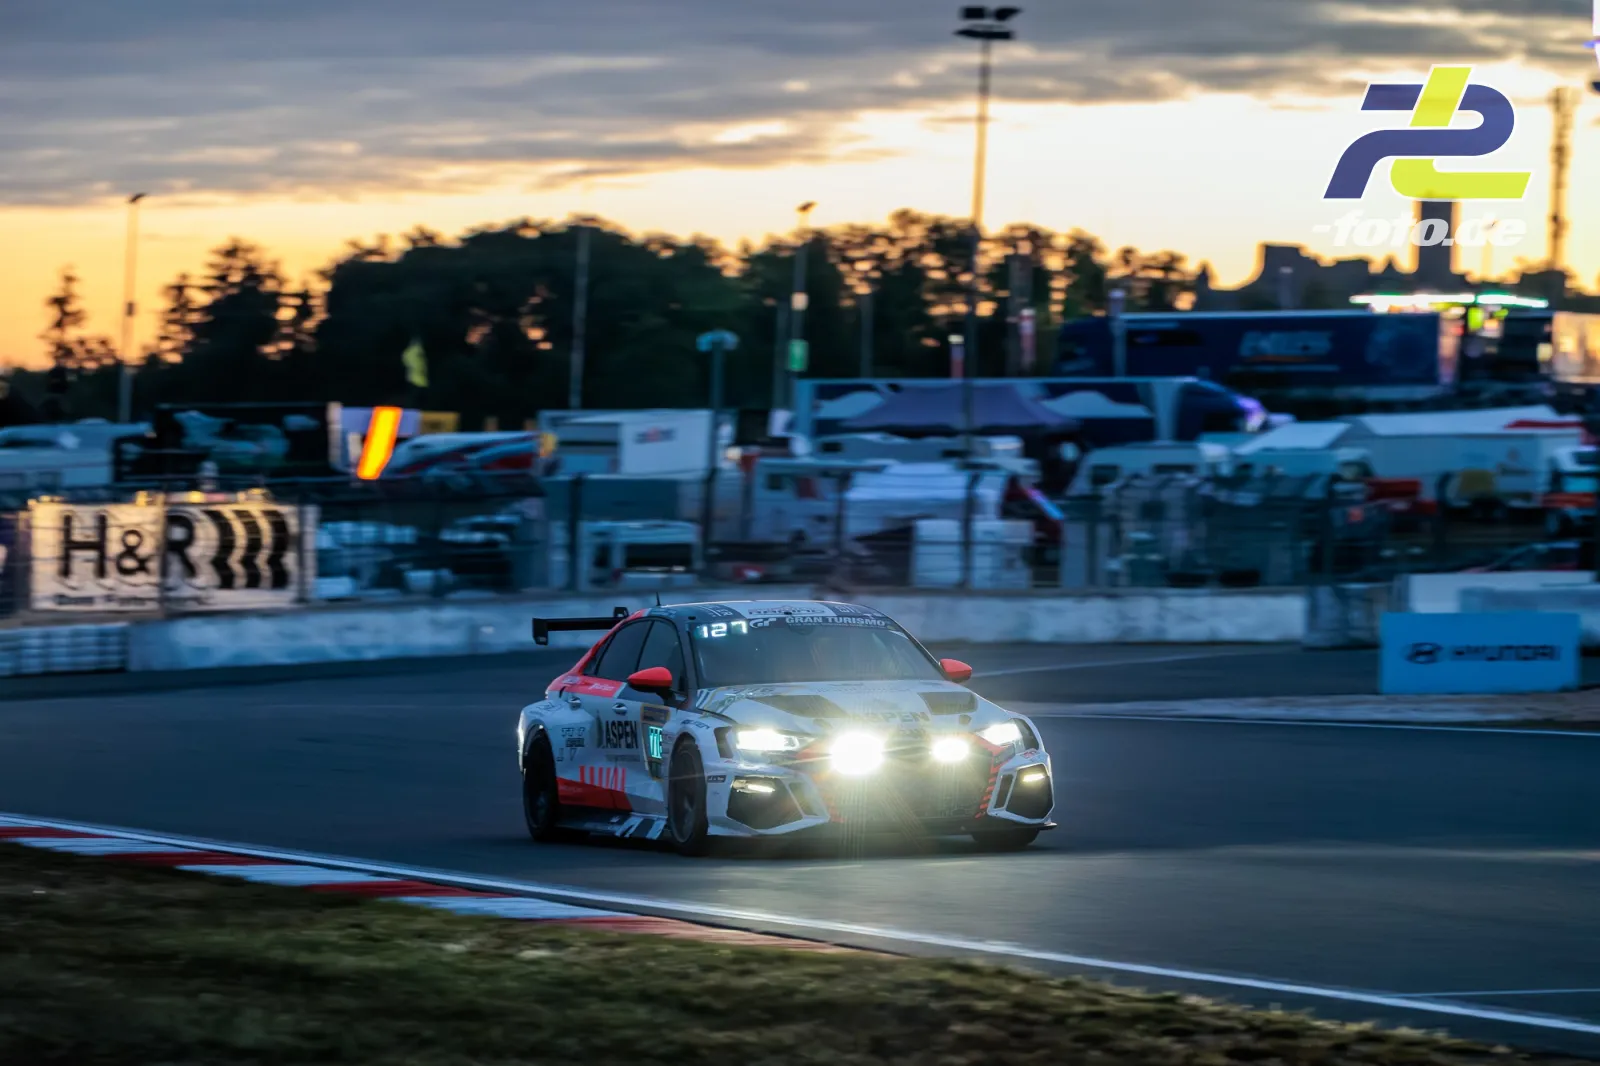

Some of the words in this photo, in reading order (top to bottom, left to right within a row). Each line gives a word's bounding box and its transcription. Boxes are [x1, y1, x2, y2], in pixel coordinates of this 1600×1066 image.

[60, 511, 198, 579] H&R
[699, 620, 748, 638] 127
[786, 616, 823, 625] GRAN
[827, 617, 886, 627] TURISMO
[605, 720, 638, 749] ASPEN
